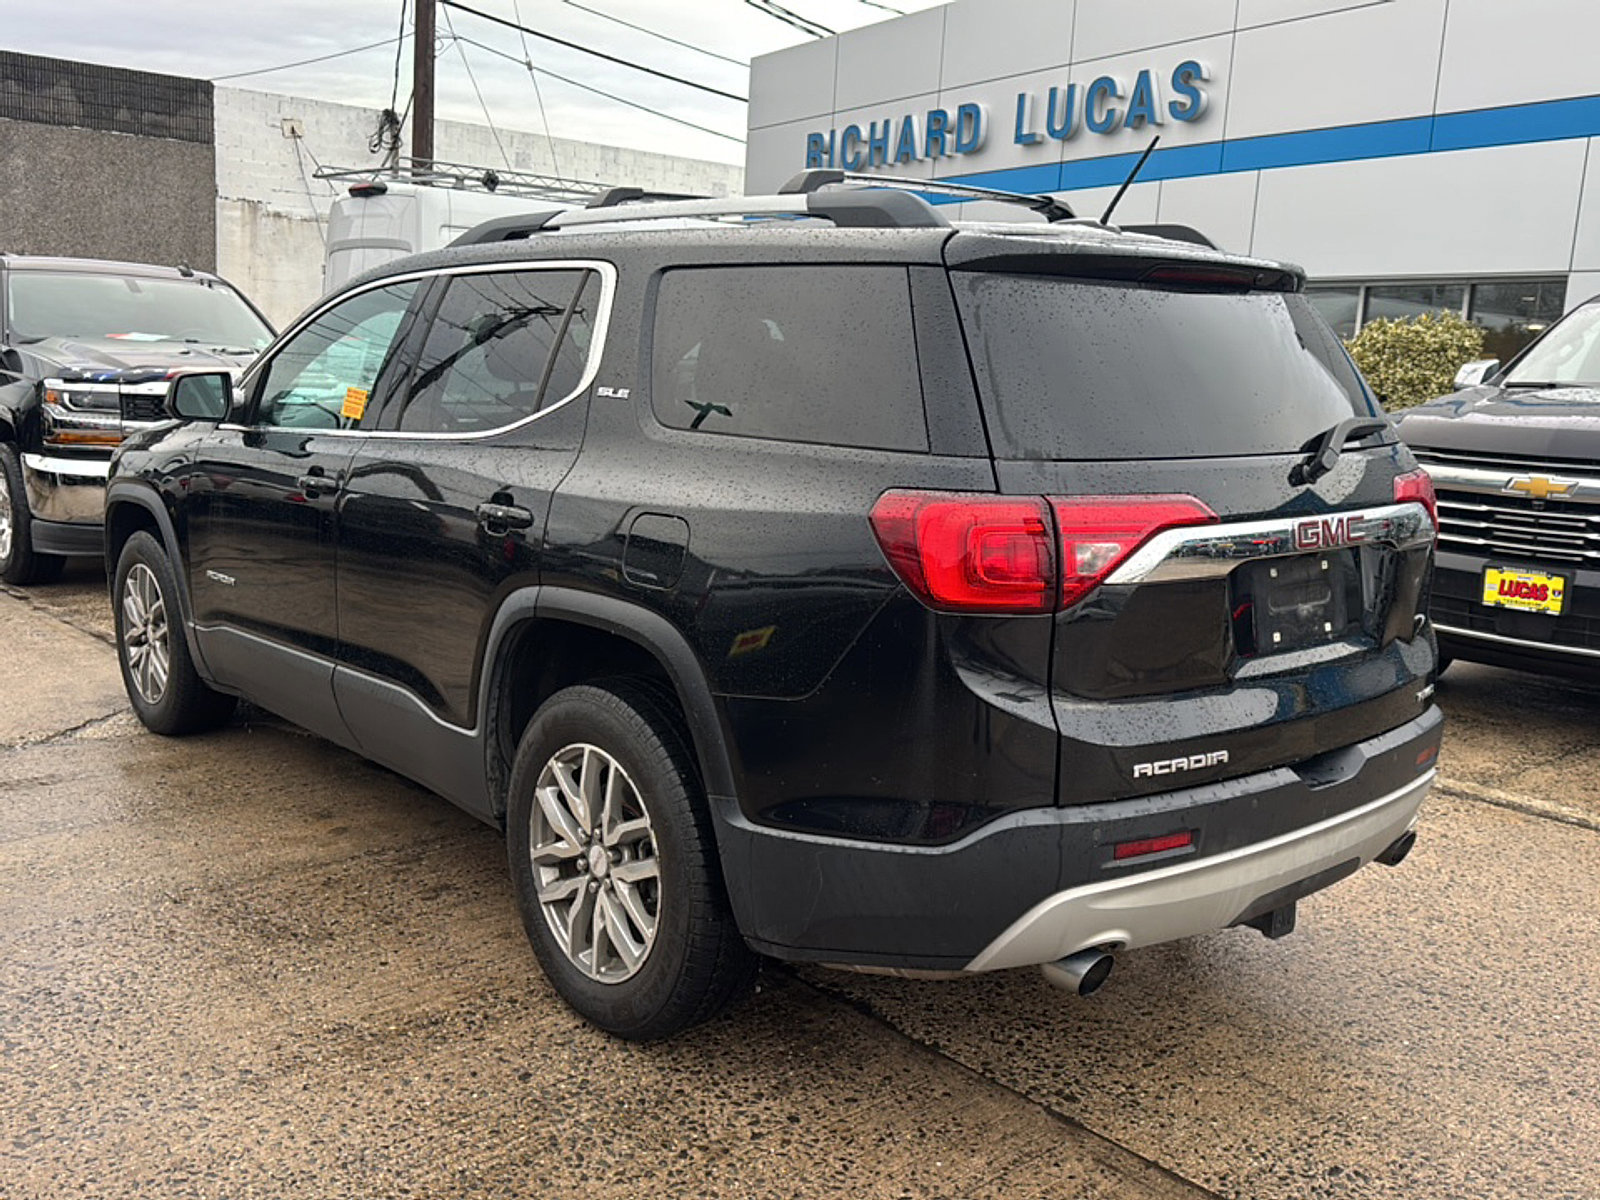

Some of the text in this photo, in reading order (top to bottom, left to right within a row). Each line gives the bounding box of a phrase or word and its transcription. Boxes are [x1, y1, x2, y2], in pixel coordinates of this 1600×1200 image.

[806, 60, 1207, 171] RICHARD LUCAS
[1296, 515, 1365, 550] GMC
[1499, 579, 1548, 601] LUCAS
[1133, 750, 1229, 778] ACADIA
